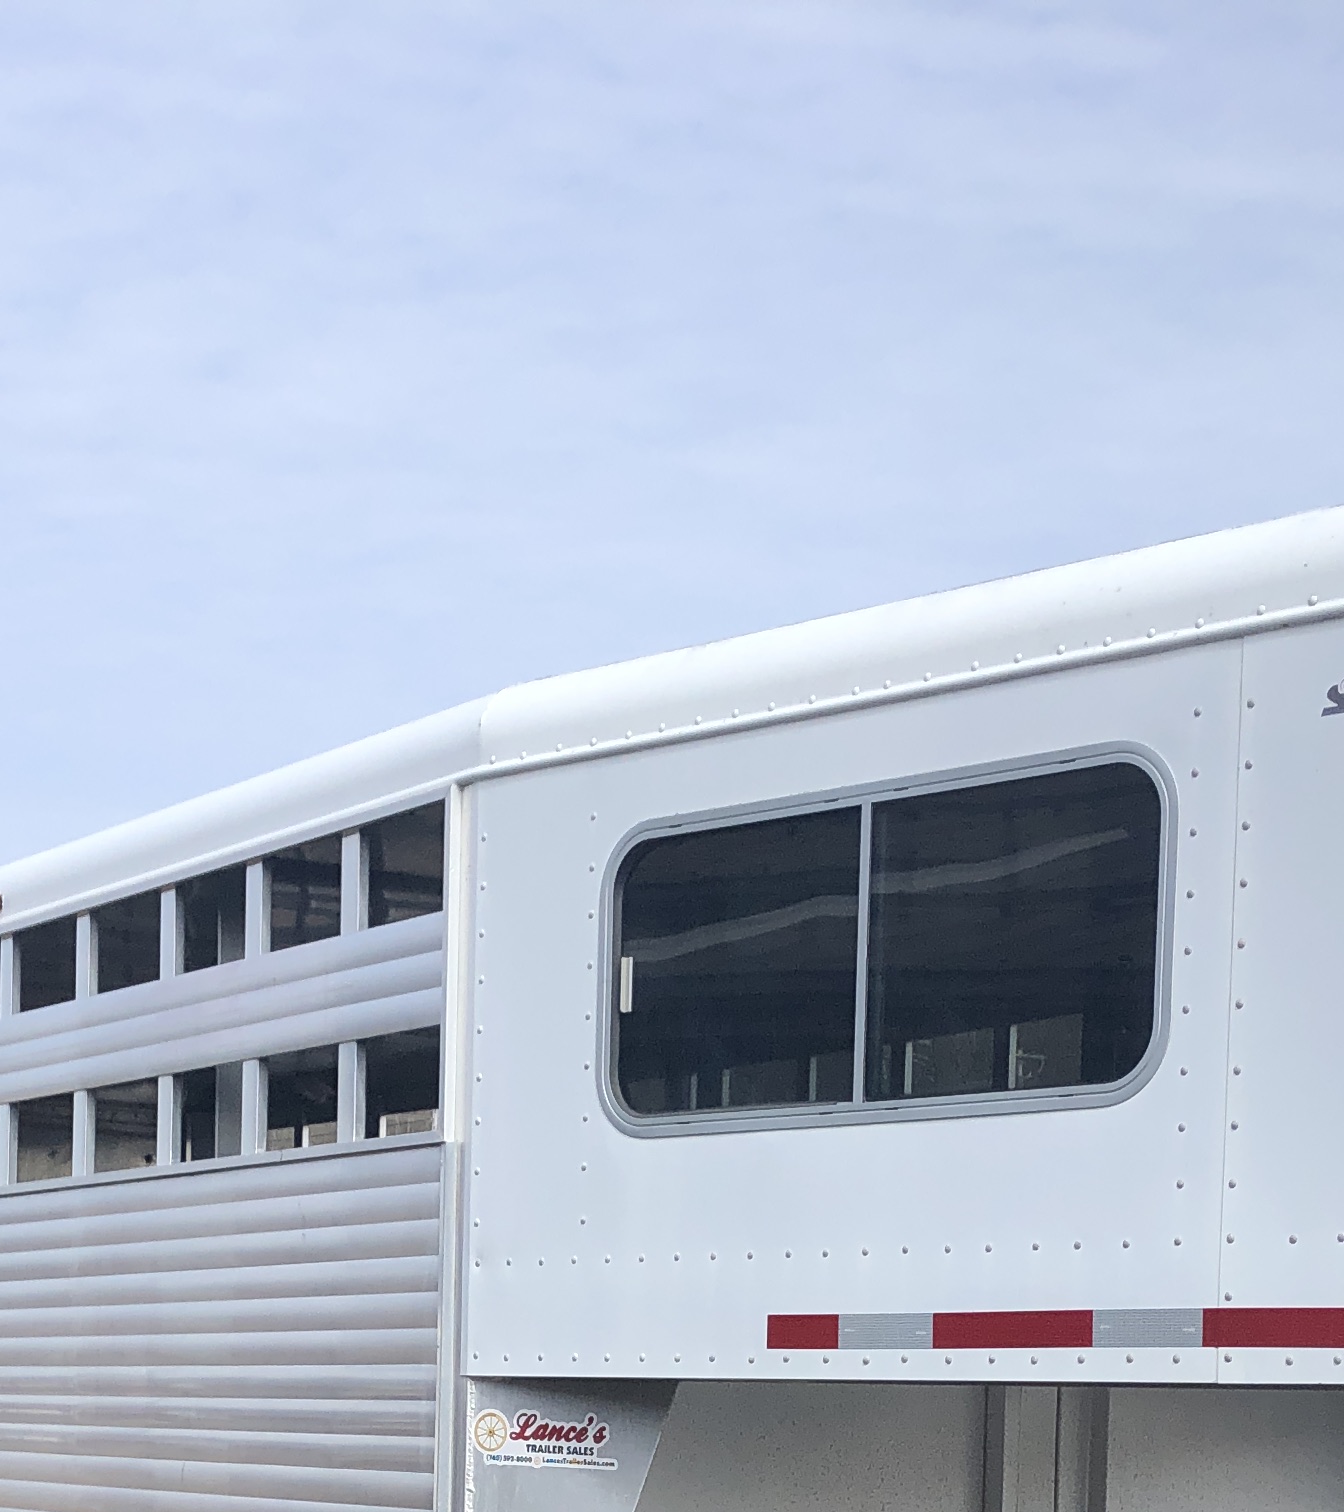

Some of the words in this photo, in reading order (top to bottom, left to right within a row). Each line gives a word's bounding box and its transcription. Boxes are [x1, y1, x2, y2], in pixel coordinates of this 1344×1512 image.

[509, 1412, 606, 1444] Lance's
[526, 1444, 564, 1455] TRAILER
[566, 1446, 594, 1456] SALES
